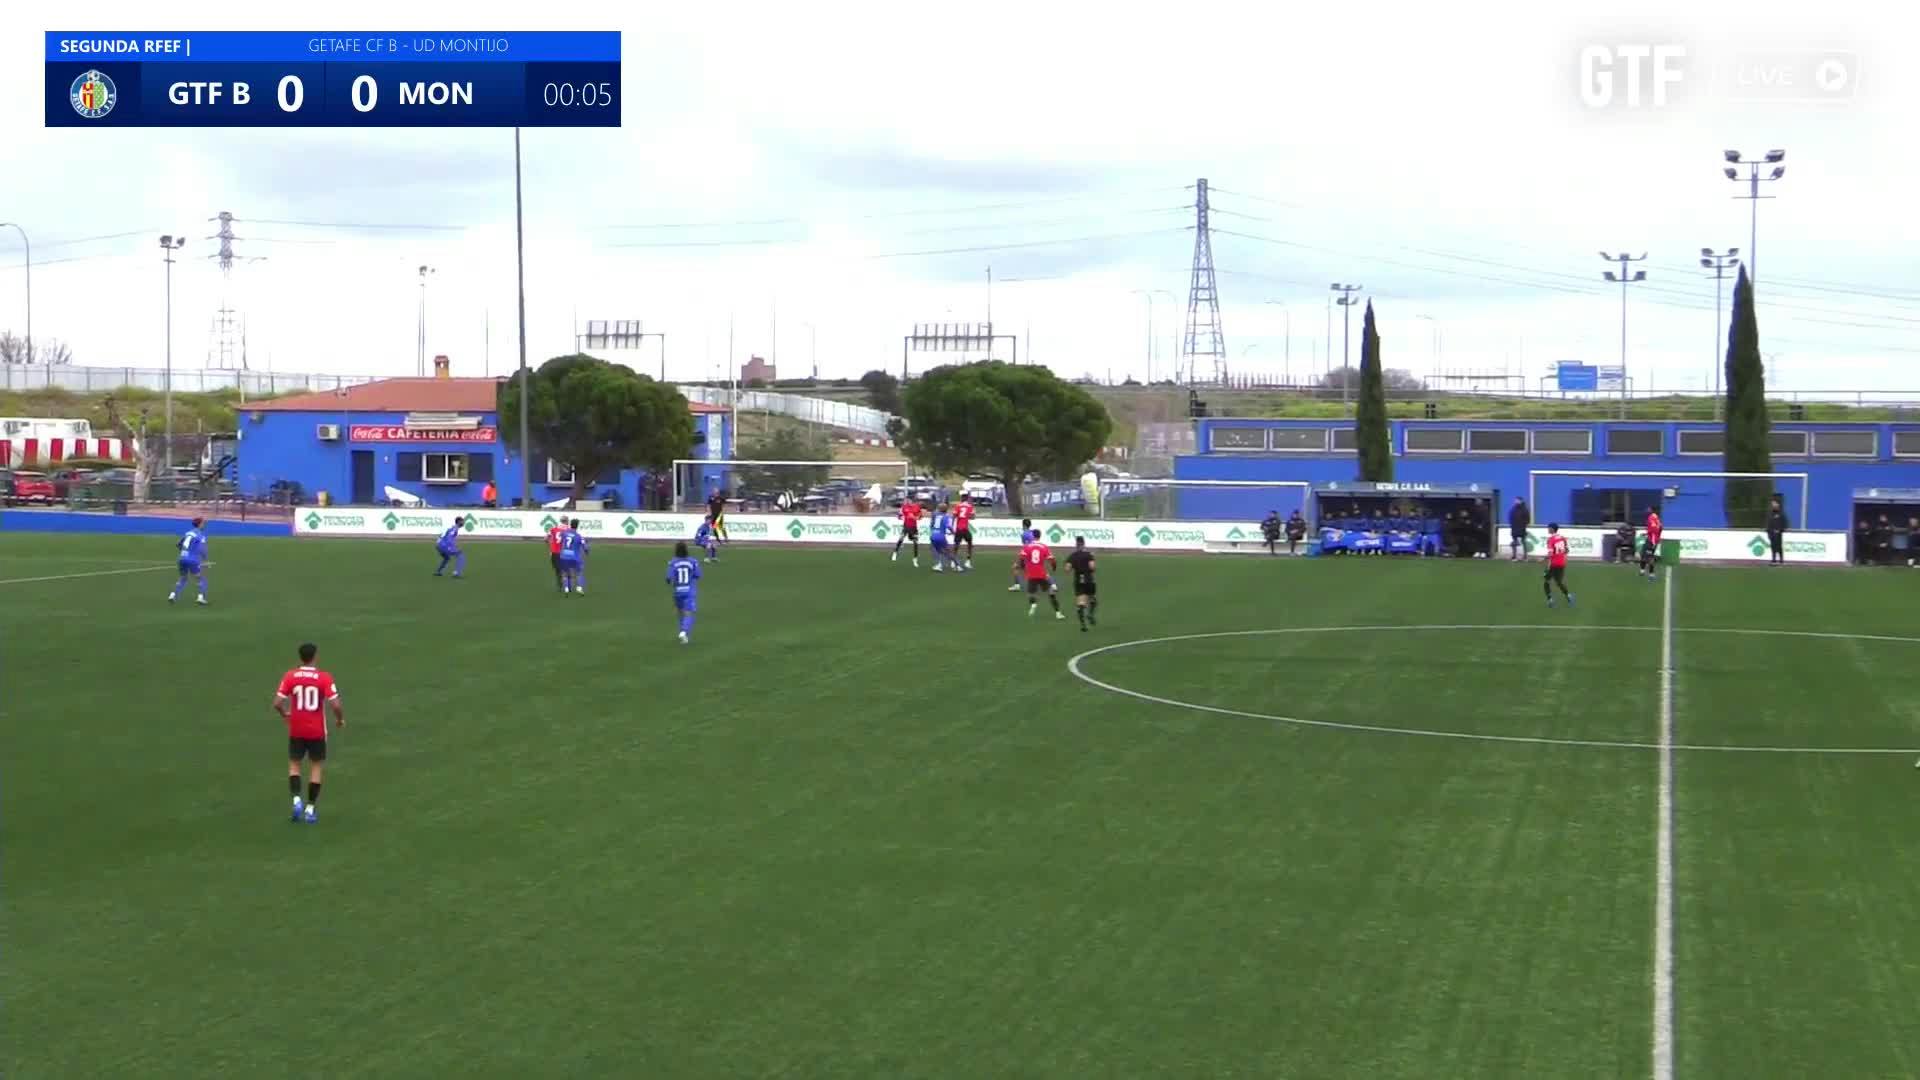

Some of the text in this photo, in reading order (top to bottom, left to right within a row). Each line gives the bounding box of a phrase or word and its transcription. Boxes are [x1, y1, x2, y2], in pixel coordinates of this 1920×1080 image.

[566, 536, 572, 548] 7
[1031, 549, 1040, 564] 8
[677, 567, 689, 584] 11
[293, 684, 319, 711] 10
